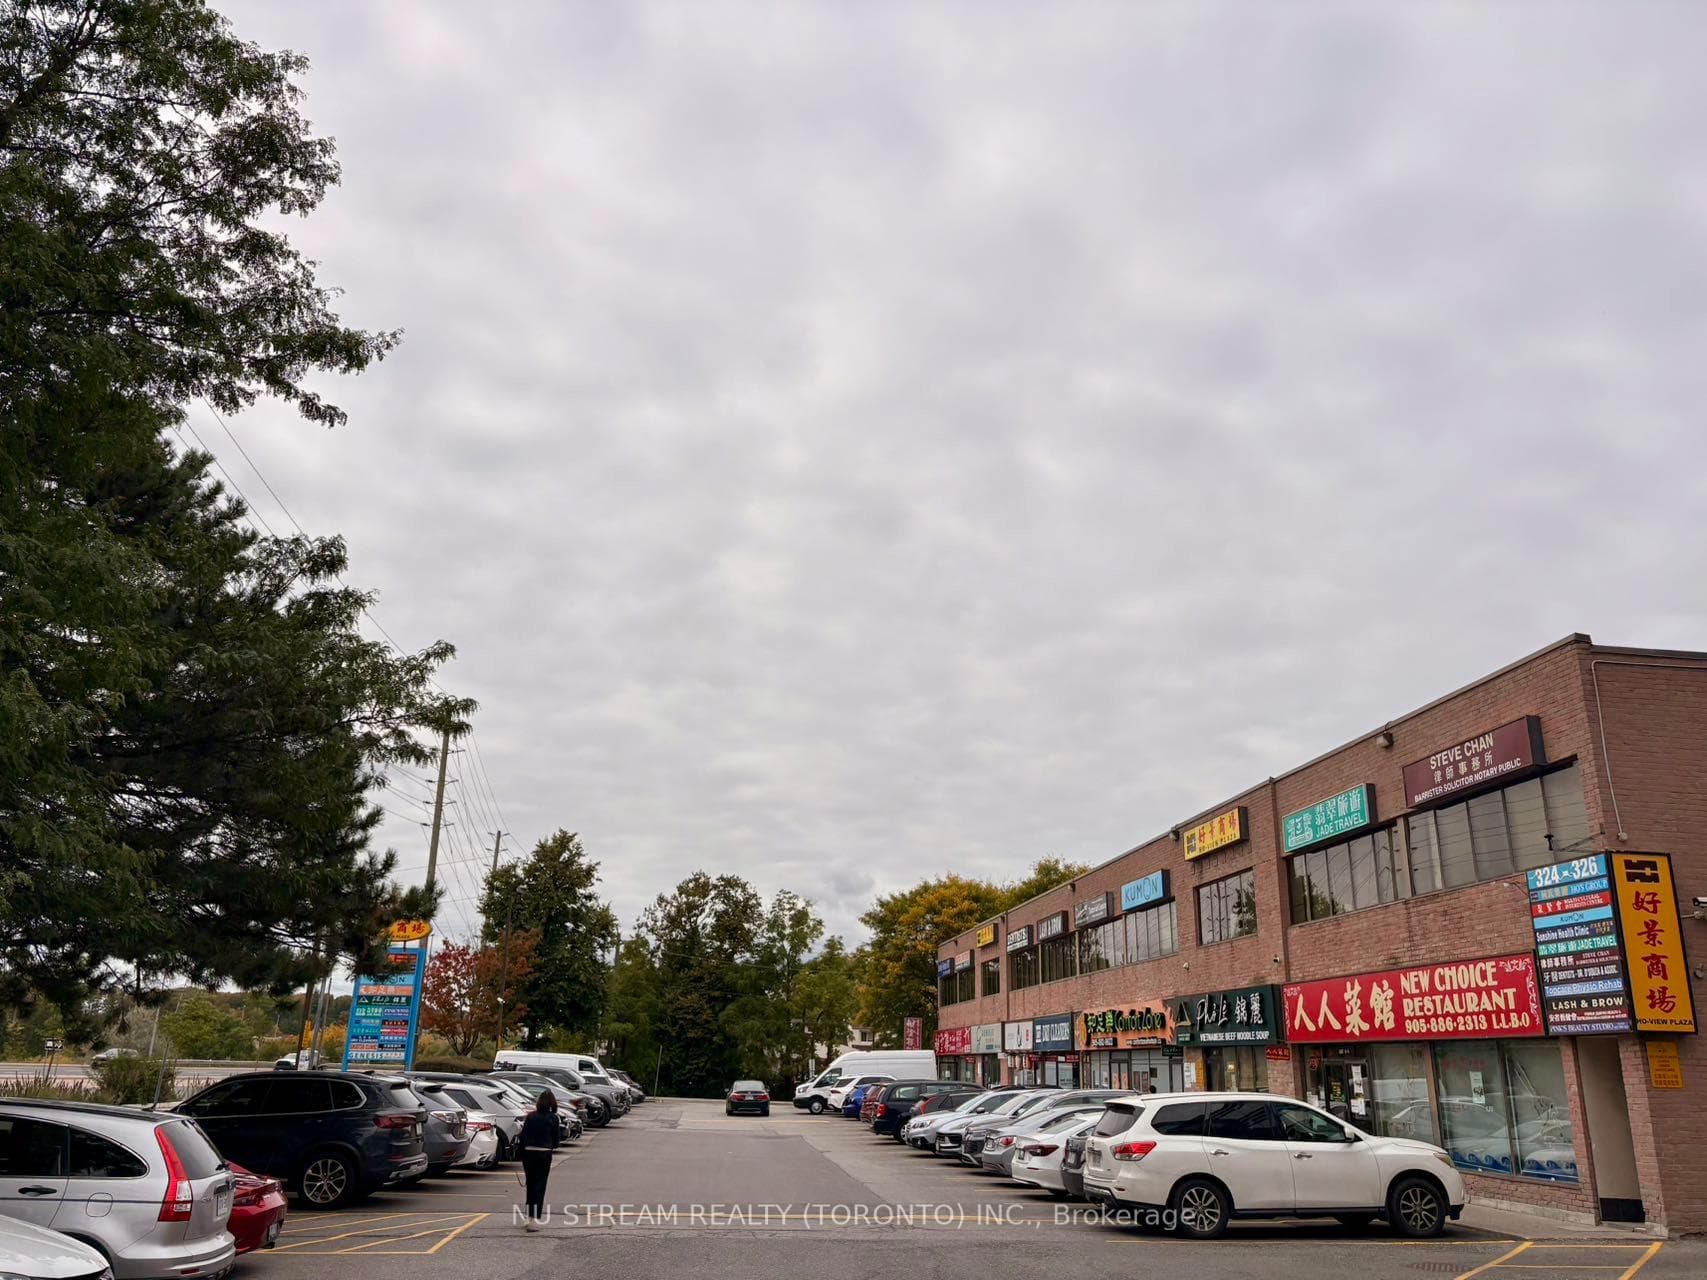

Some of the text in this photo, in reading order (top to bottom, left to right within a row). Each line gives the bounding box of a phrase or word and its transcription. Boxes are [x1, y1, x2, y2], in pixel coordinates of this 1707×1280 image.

[1430, 733, 1494, 769] STEVE CHAN
[1414, 757, 1522, 803] BARRISTER SOLICITOR NOTARY PUBLIC
[1316, 821, 1335, 838] JADE
[1335, 811, 1364, 829] TRAVEL
[1124, 876, 1159, 902] KUMON
[1557, 927, 1575, 940] Health
[1574, 925, 1590, 936] Clinic
[1579, 935, 1617, 950] JADE TRAVEL
[1632, 890, 1677, 1014] 好景商場
[1400, 961, 1498, 995] NEW CHOICE
[1598, 979, 1622, 990] Rehab
[1294, 978, 1396, 1037] 人人菜館
[1402, 988, 1516, 1017] RESTAURANT
[1552, 996, 1623, 1011] LASH & BROW
[1669, 1018, 1694, 1026] PLAZA
[1200, 1033, 1225, 1042] VIETNAMESE
[1225, 1032, 1237, 1041] BEEF
[1237, 1031, 1255, 1040] NOODLE
[1255, 1030, 1270, 1040] SOUP
[351, 1052, 384, 1060] GENESIS
